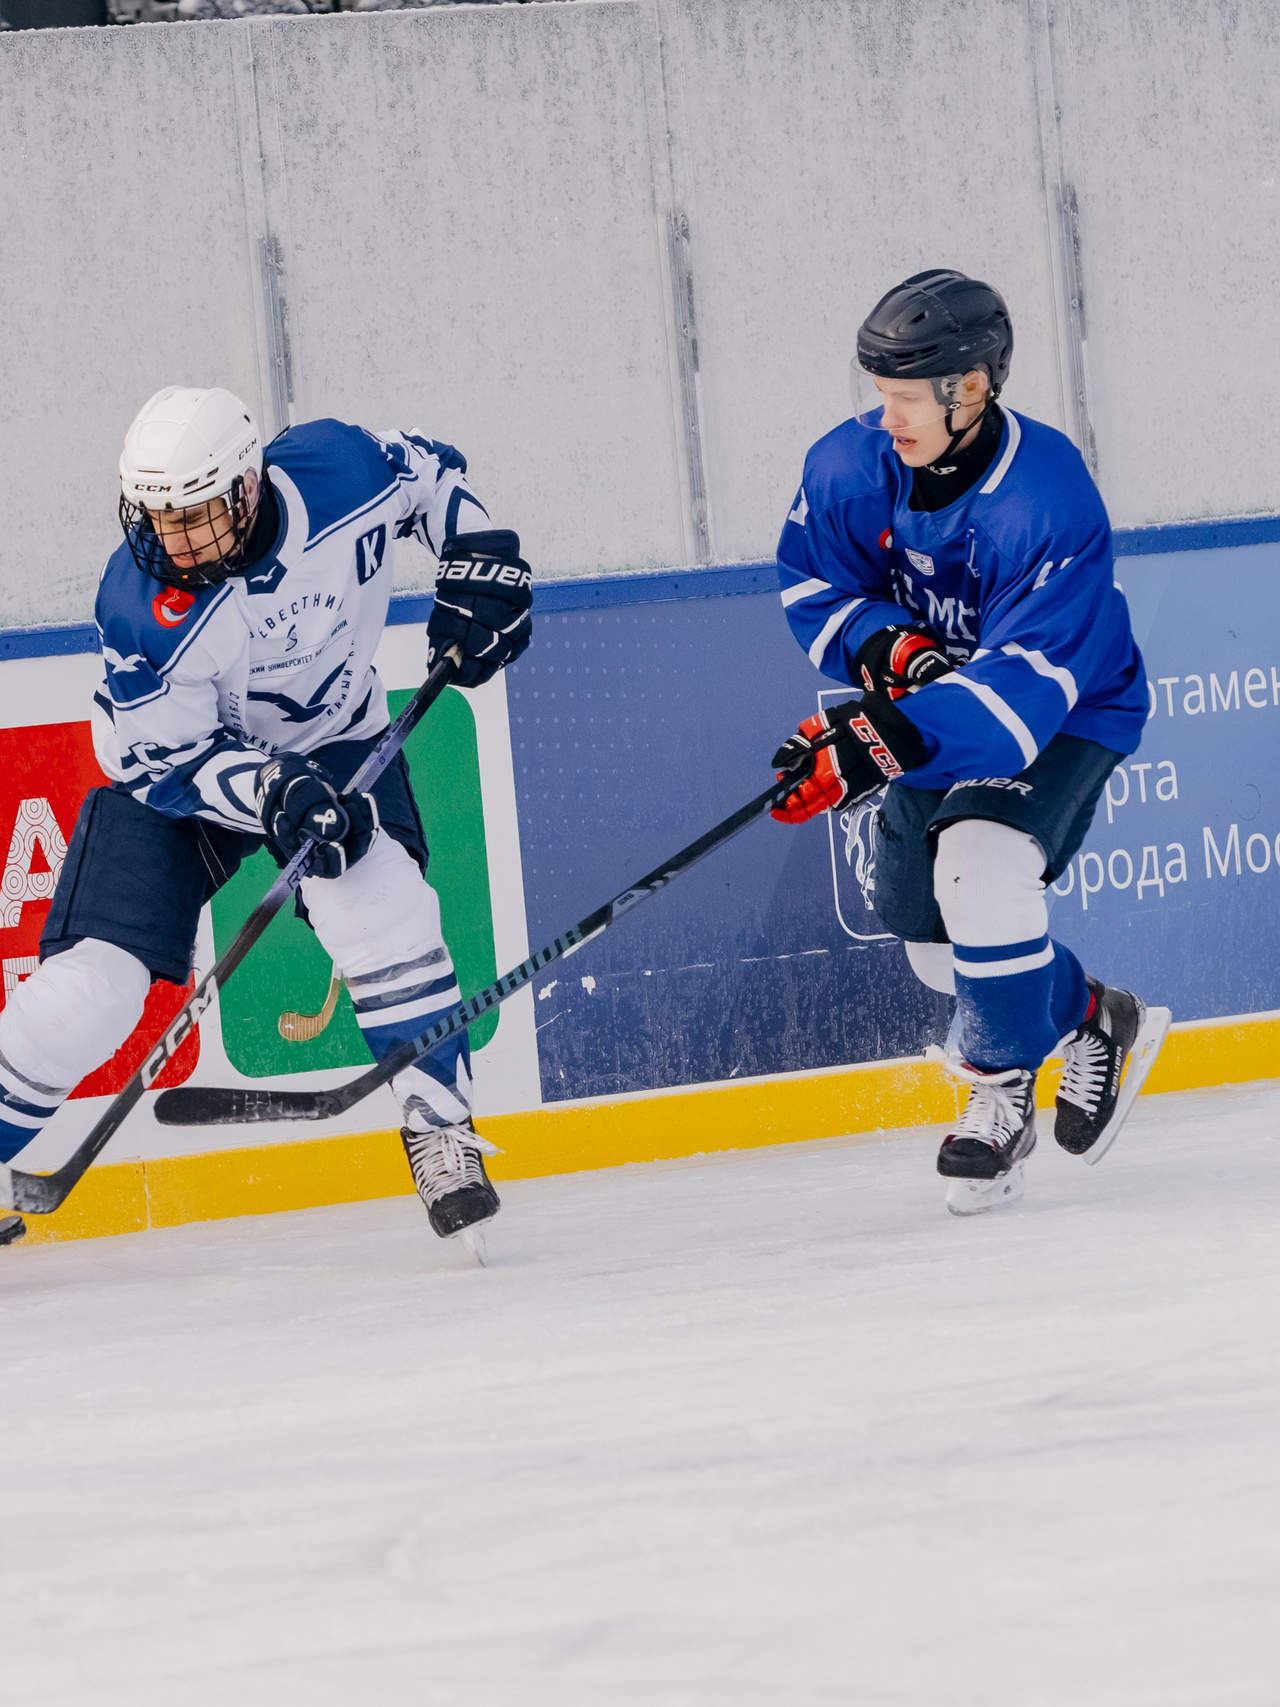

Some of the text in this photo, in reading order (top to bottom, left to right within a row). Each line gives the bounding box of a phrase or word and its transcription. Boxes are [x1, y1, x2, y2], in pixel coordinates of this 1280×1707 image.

[238, 437, 257, 461] CCM
[134, 483, 172, 493] CCM
[435, 560, 533, 592] BAUER
[267, 653, 314, 672] УНИВЕРСИТЕТ
[1202, 823, 1280, 880] Мо
[412, 923, 584, 1055] WARRIOR
[140, 974, 219, 1090] CCM
[1110, 1045, 1123, 1097] BAUER
